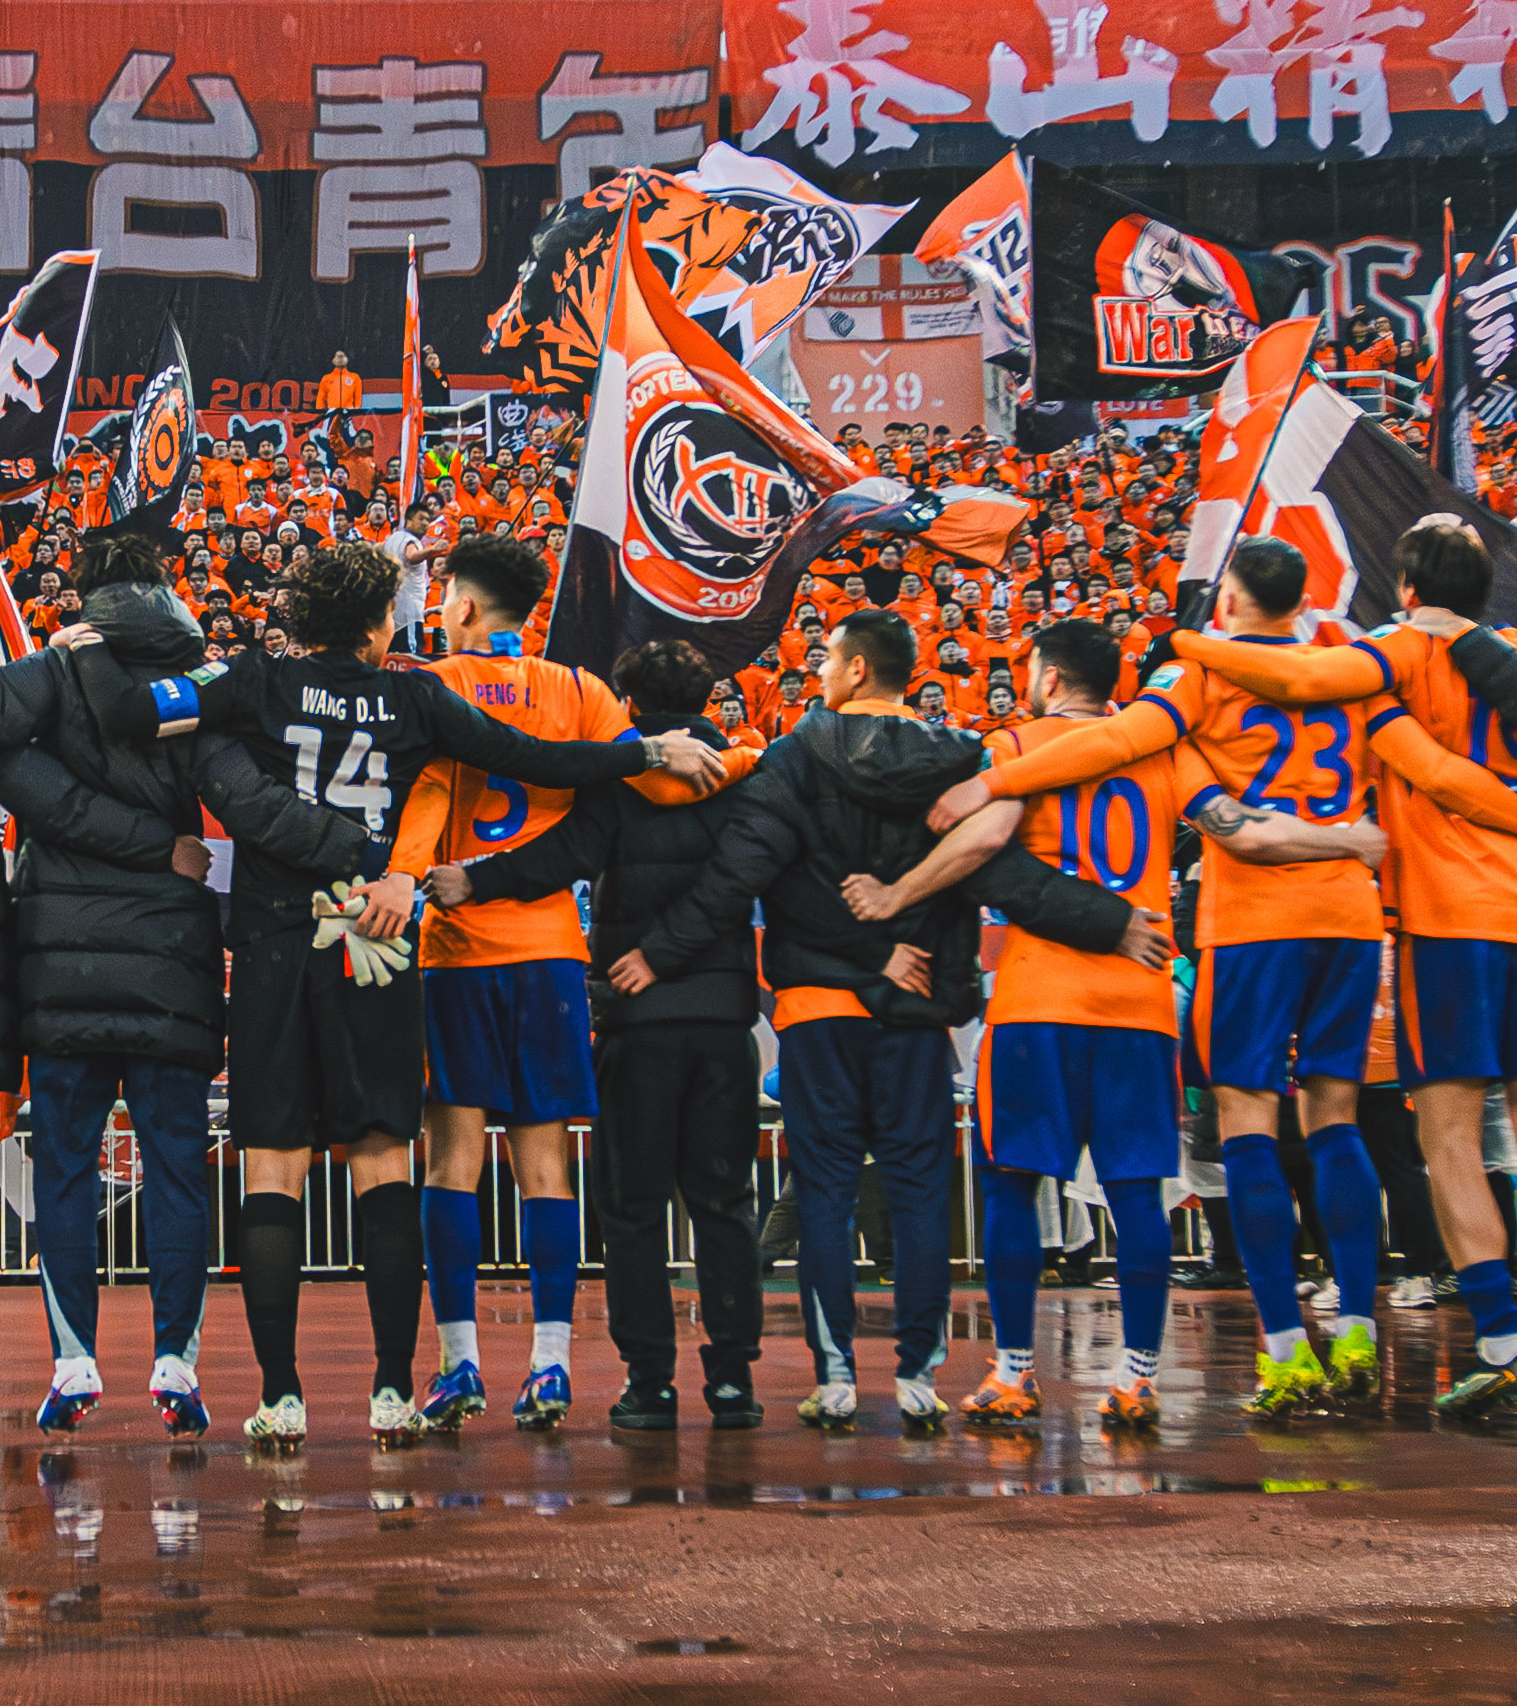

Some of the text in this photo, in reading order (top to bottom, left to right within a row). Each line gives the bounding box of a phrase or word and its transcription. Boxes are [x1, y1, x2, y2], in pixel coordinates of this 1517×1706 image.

[828, 371, 923, 414] 229
[302, 685, 347, 721] WANG
[474, 682, 517, 706] PENG
[284, 725, 392, 832] 14
[1240, 703, 1355, 819] 23
[1059, 776, 1151, 893] 10
